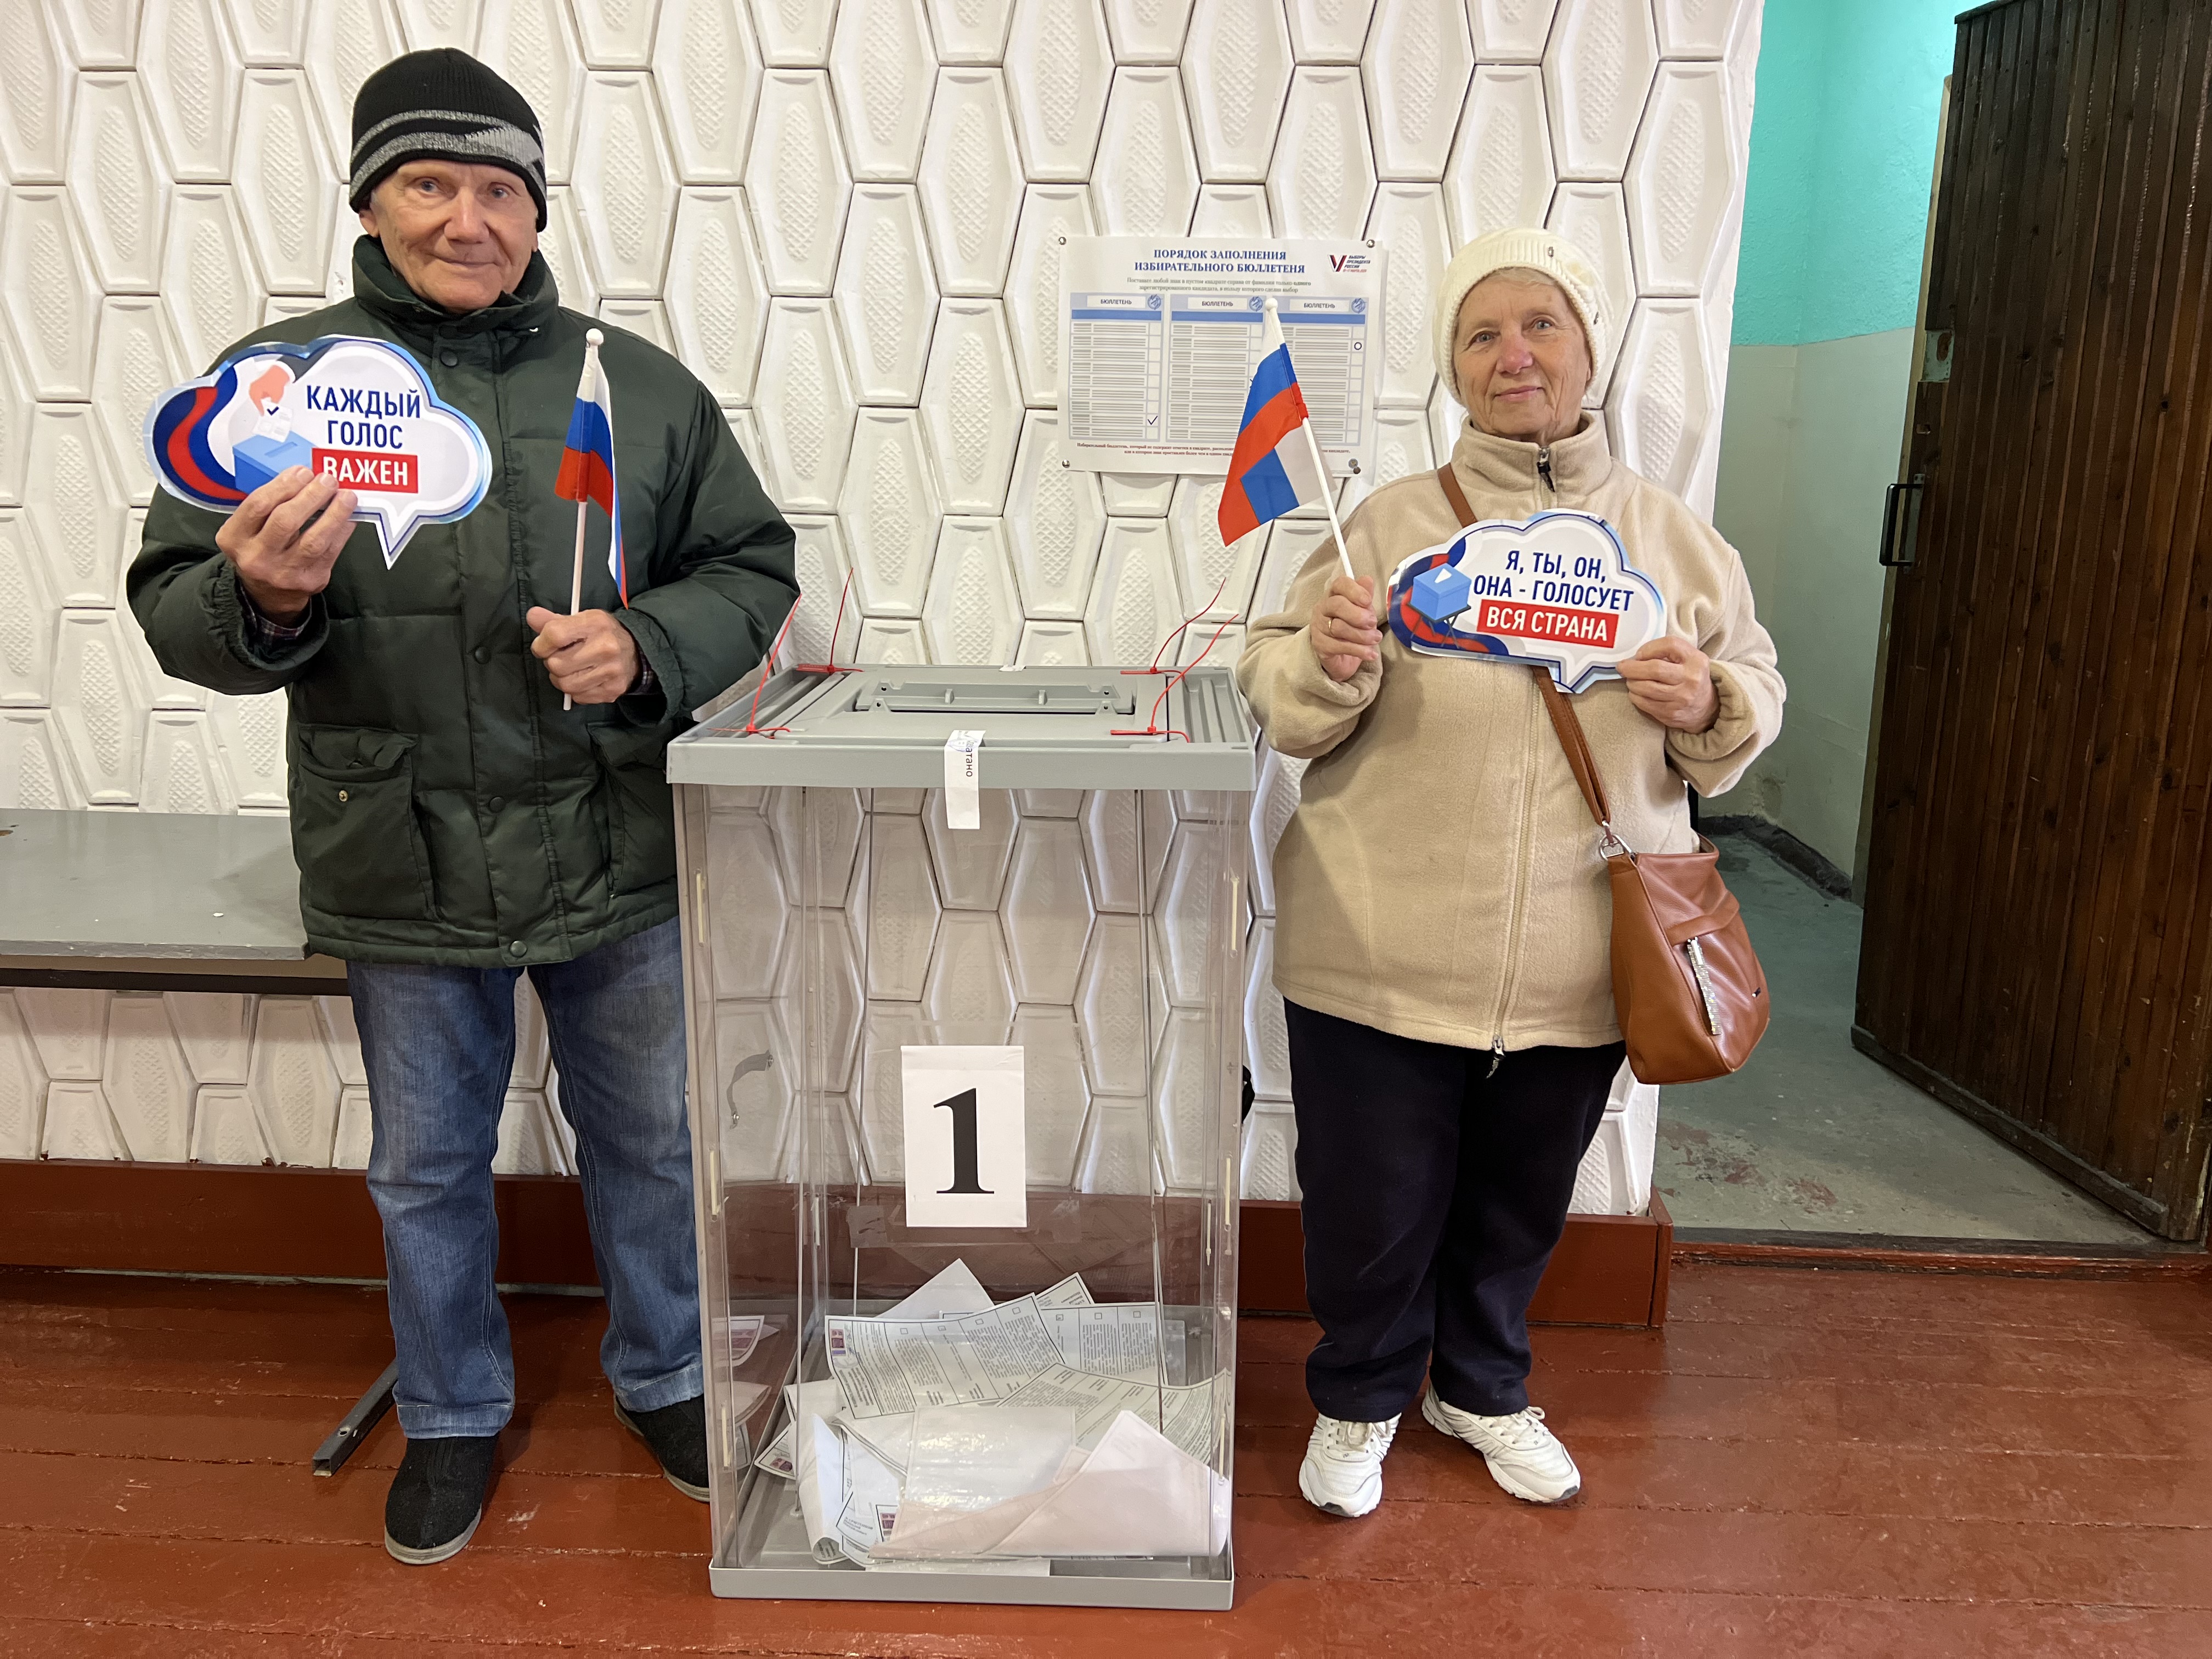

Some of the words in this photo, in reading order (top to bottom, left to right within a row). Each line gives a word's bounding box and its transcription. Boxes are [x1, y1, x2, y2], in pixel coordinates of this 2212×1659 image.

[1135, 262, 1234, 272] ИЗБИРАТЕЛЬНОГО
[1237, 263, 1305, 273] БЮЛЛЕТЕНЯ
[1154, 250, 1207, 259] ПОРЯДОК
[1210, 250, 1286, 260] ЗАПОЛНЕНИЯ
[306, 385, 421, 419] КАЖДЫЙ
[327, 420, 403, 449] ГОЛОС
[323, 456, 408, 486] ВАЖЕН
[1505, 550, 1524, 574] Я,
[1532, 552, 1566, 580] ТЫ,
[1574, 556, 1606, 584] ОН,
[1473, 574, 1512, 598] ОНА
[1532, 580, 1634, 611] ГОЛОСУЕТ
[1486, 606, 1525, 631] ВСЯ
[1531, 612, 1607, 642] СТРАНА
[933, 1087, 995, 1194] 1
